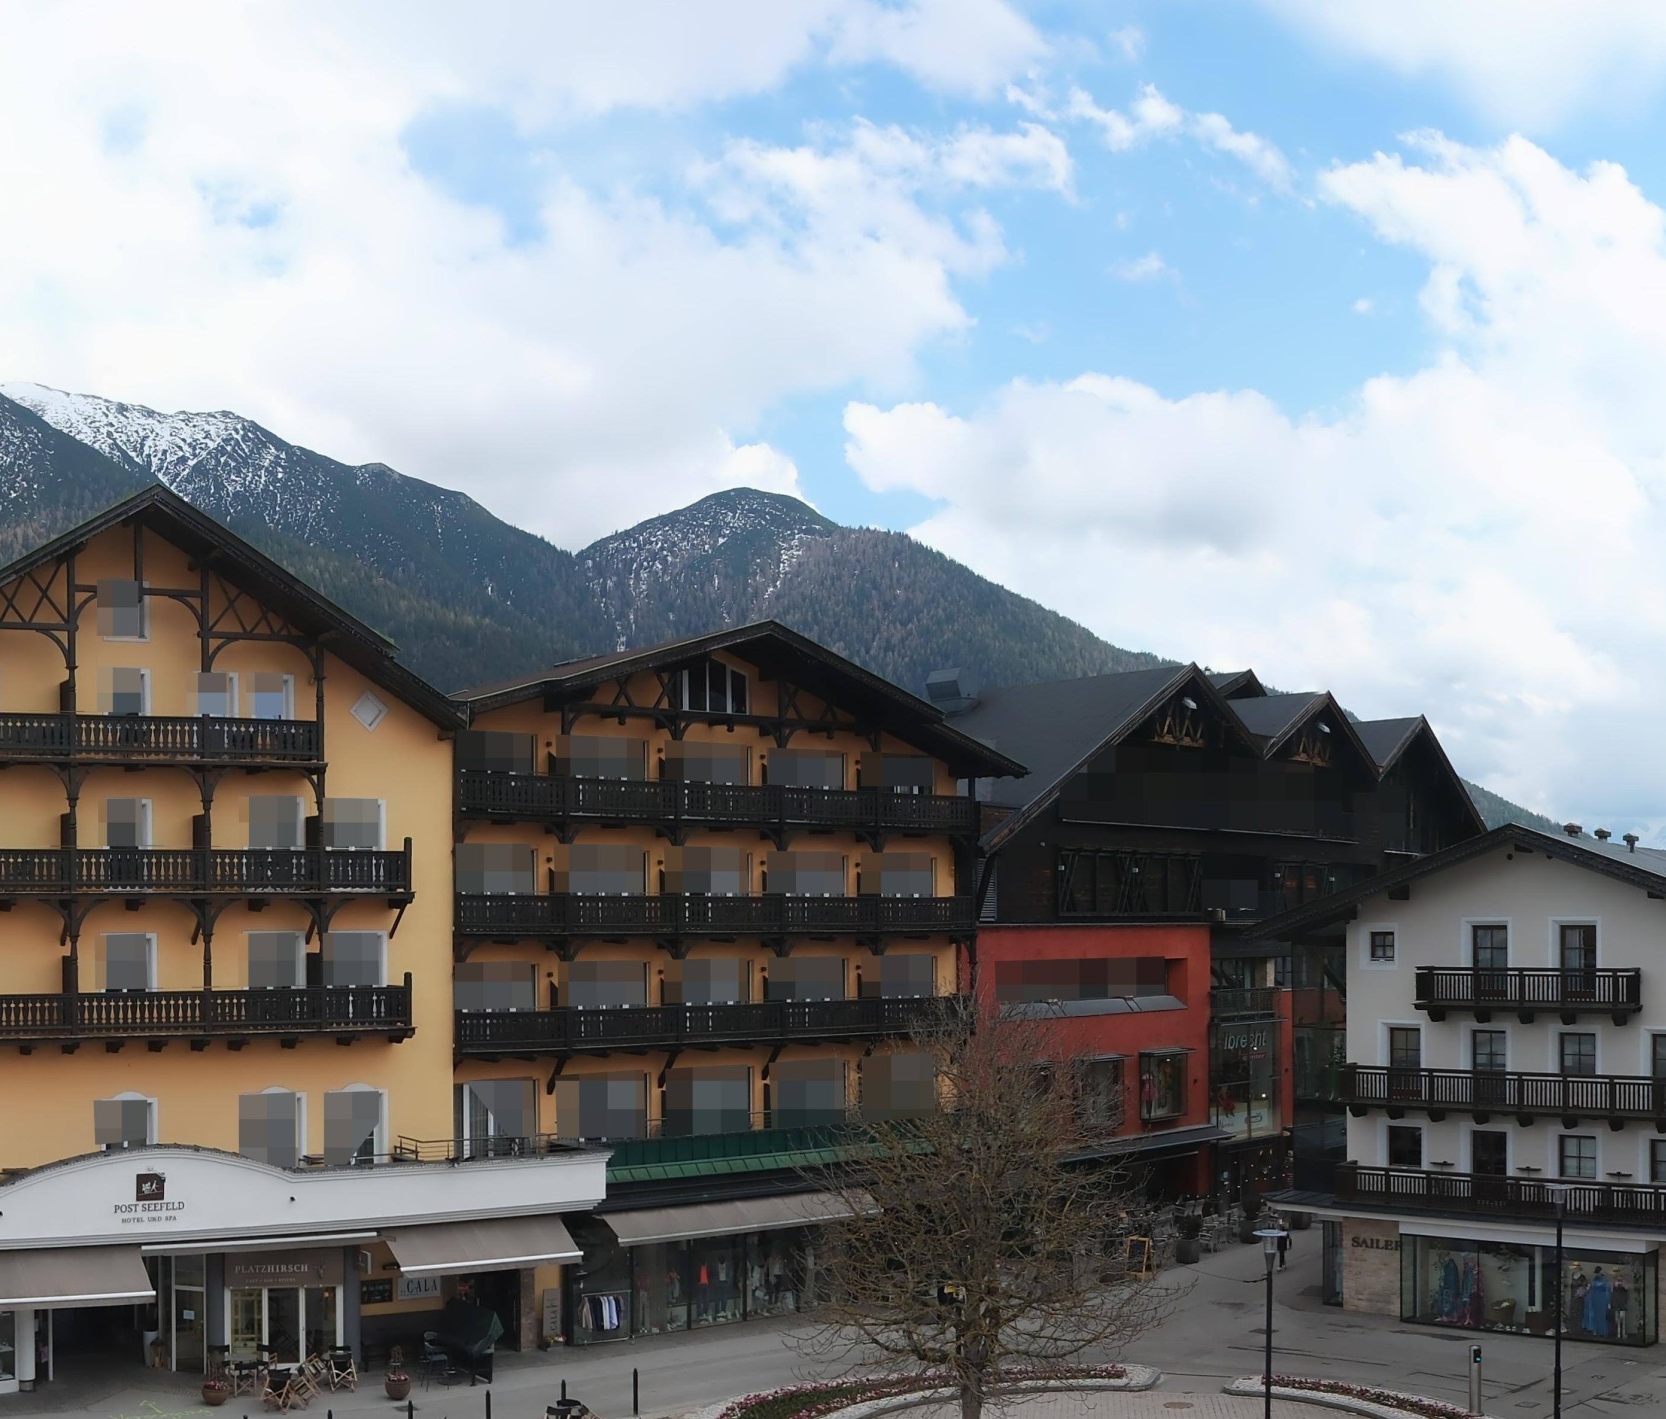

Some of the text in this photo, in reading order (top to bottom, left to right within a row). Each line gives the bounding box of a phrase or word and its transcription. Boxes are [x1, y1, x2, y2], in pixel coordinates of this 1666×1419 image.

[114, 1201, 185, 1214] POST SEEFELD
[235, 1264, 308, 1274] PLATZHIRSCH
[406, 1278, 437, 1294] CALA
